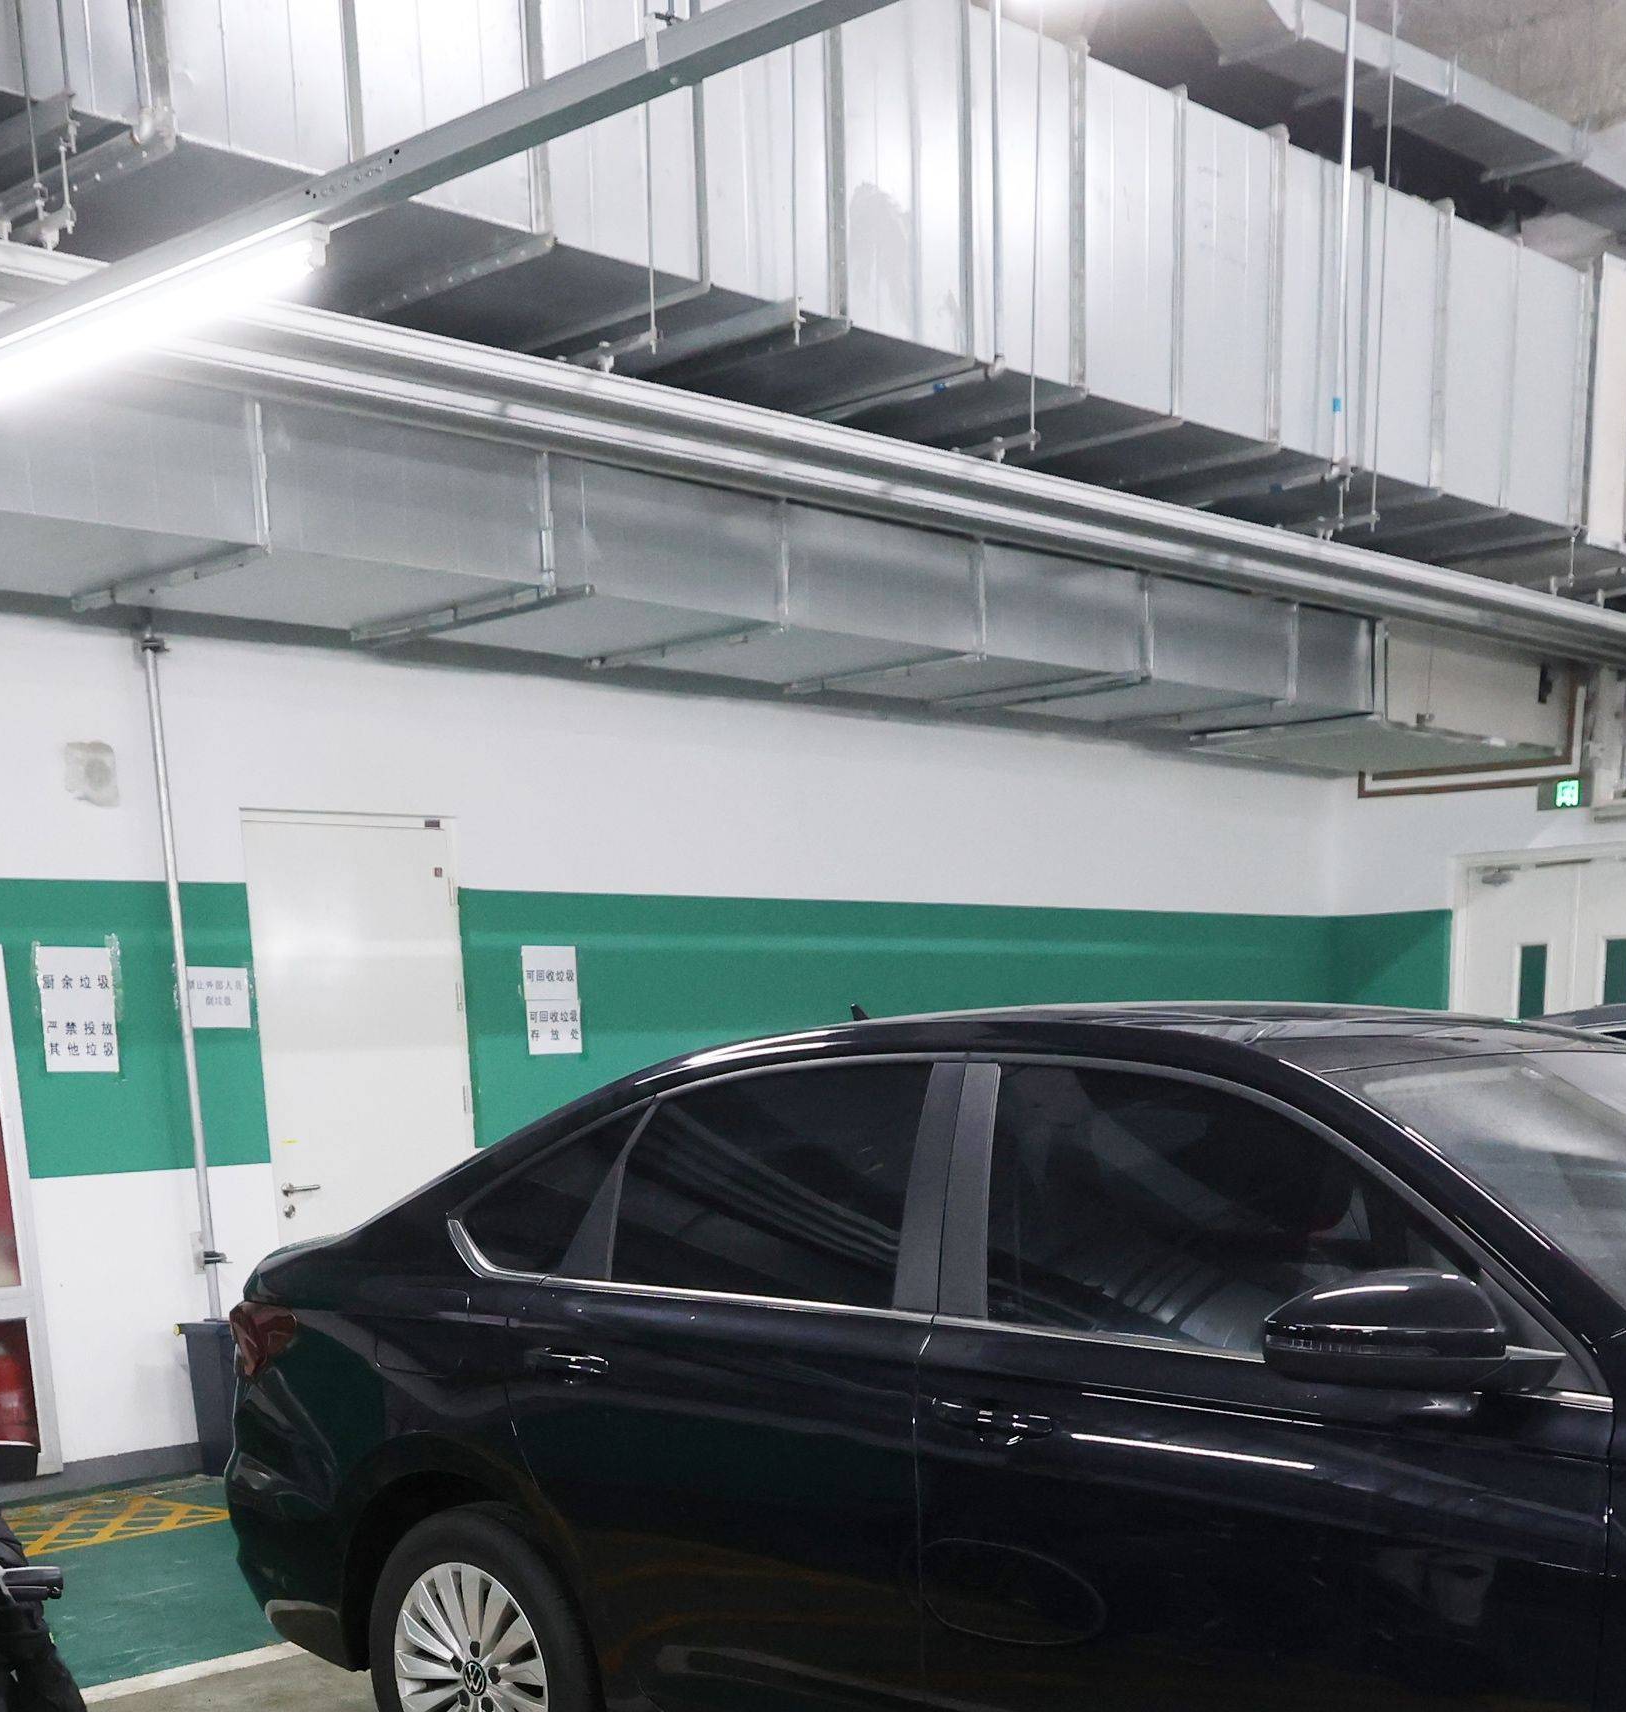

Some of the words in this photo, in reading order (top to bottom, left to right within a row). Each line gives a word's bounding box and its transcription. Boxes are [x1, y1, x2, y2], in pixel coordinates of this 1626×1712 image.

[42, 974, 110, 990] 厨余垃圾
[525, 968, 575, 982] 可回收垃圾
[529, 1010, 579, 1024] 可回收垃圾
[46, 1020, 114, 1036] 严禁投放
[530, 1027, 580, 1042] 存放处
[49, 1042, 114, 1057] 其他垃圾
